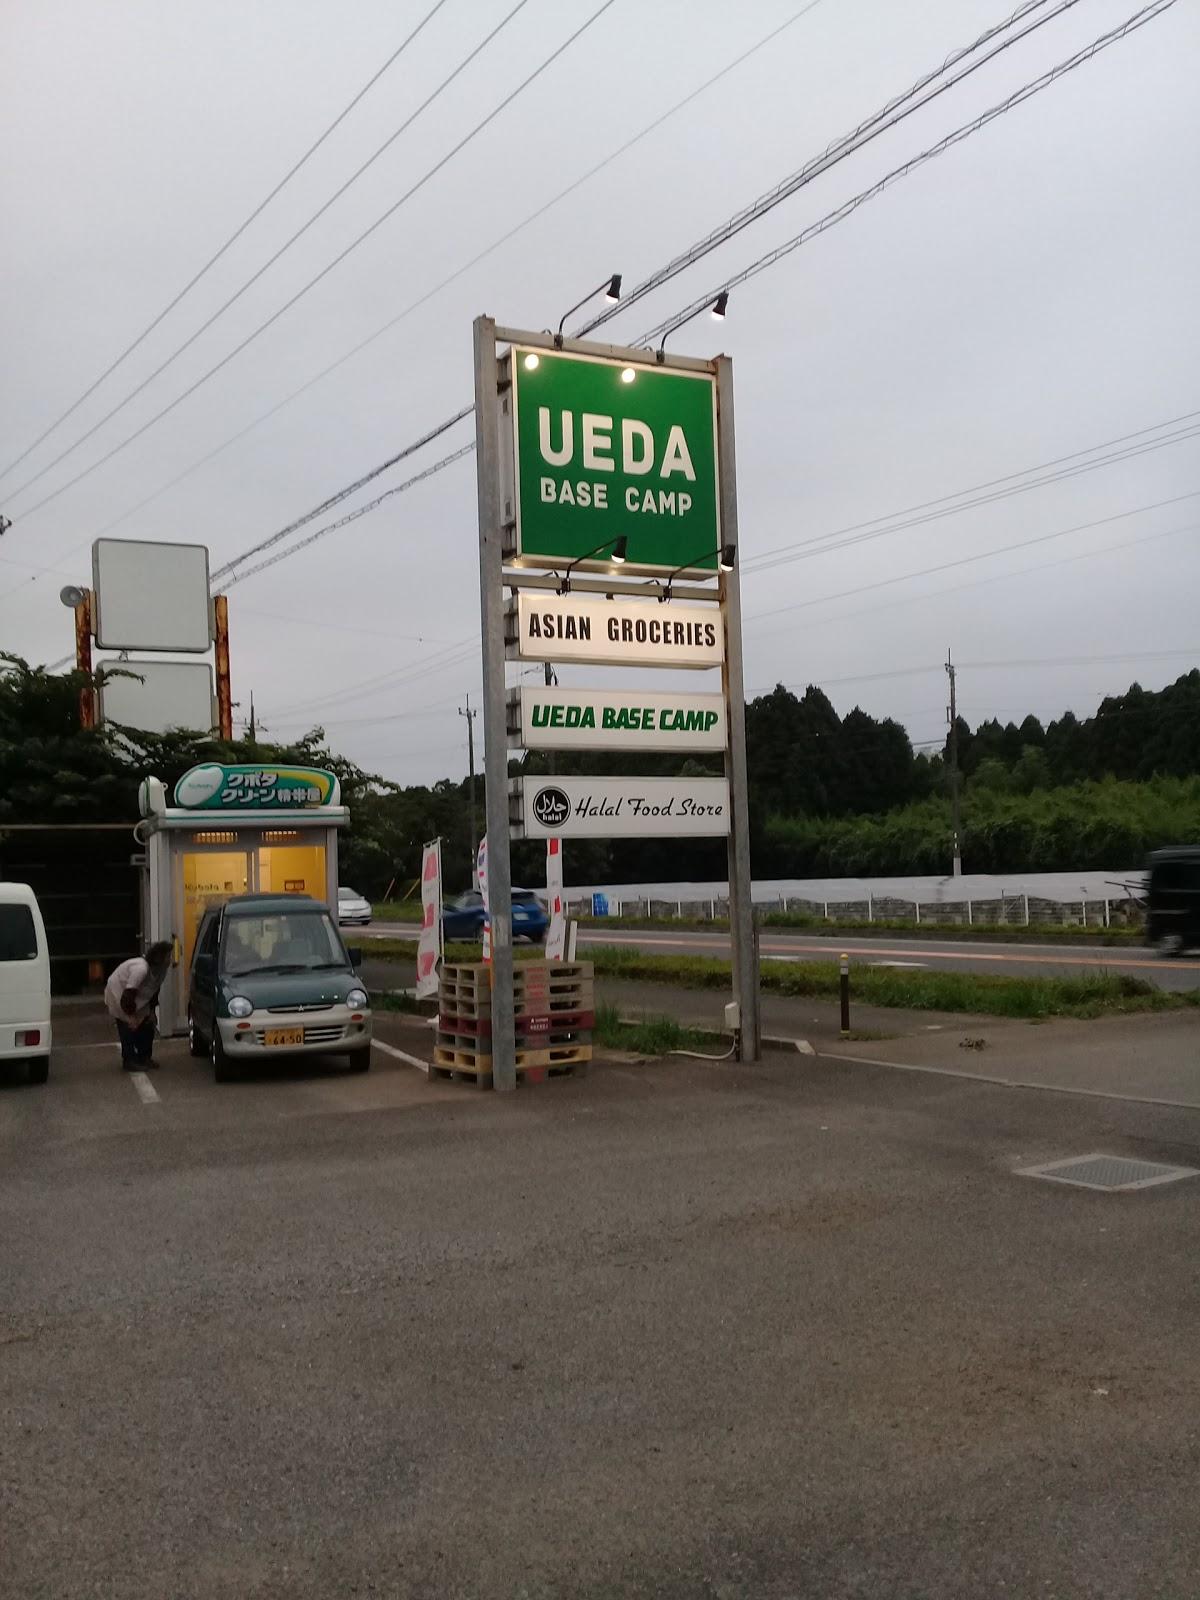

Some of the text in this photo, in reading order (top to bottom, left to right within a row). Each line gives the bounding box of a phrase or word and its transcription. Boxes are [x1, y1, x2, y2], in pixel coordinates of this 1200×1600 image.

[537, 406, 697, 482] UEDA
[540, 477, 693, 518] BASE CAMP
[528, 613, 716, 648] ASIAN GROCERIES
[531, 704, 719, 732] UEDA BASE CAMP
[228, 773, 277, 787] クボタ
[542, 812, 562, 822] halal
[575, 796, 723, 818] Halal Food Store
